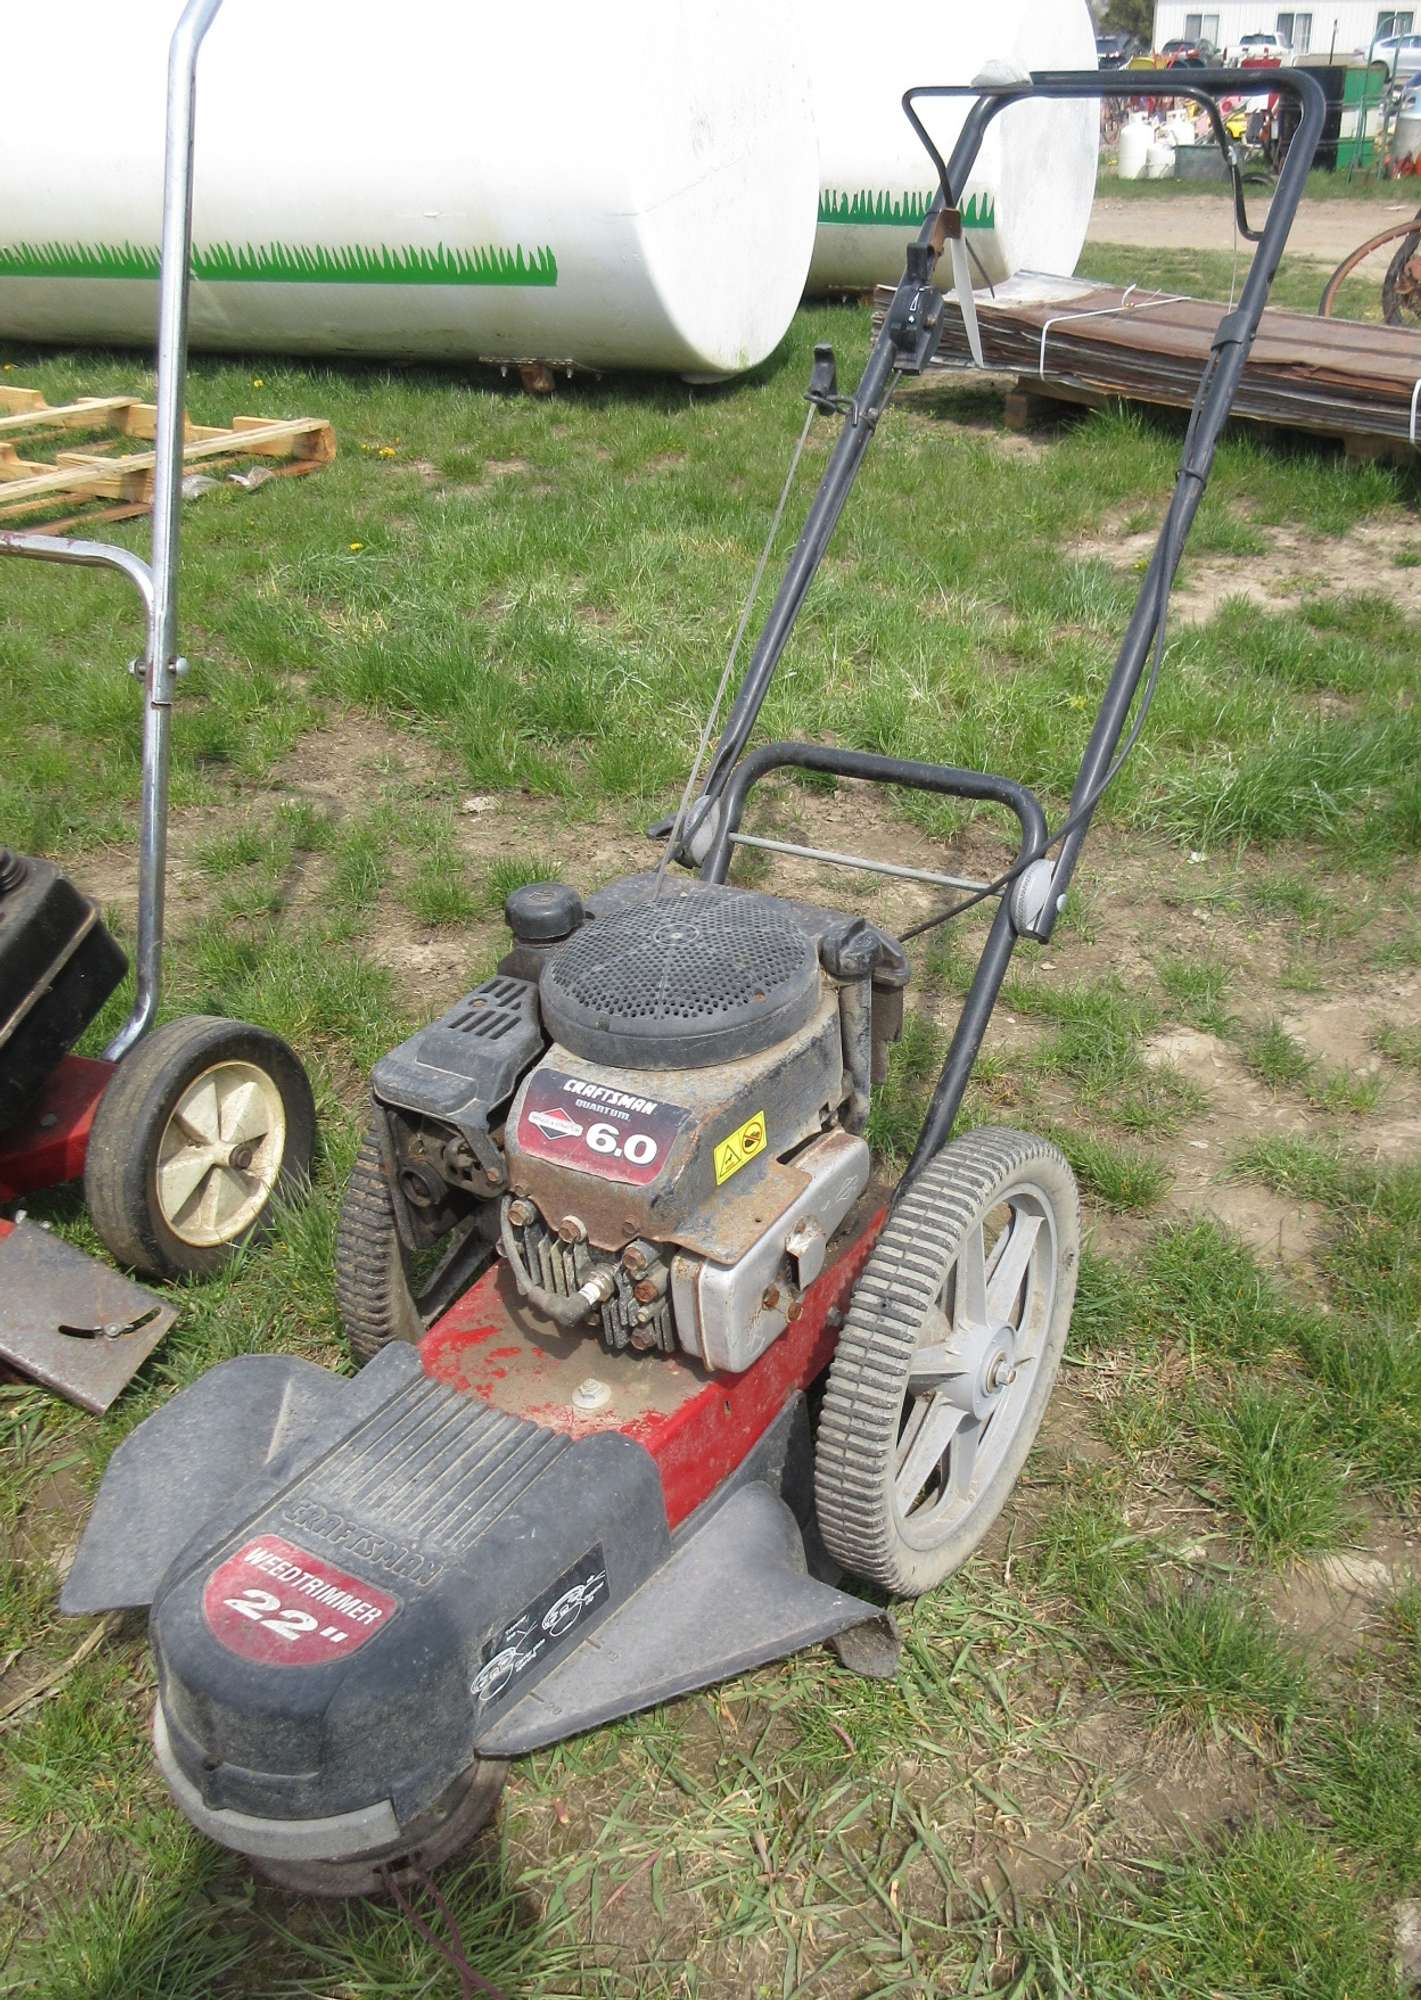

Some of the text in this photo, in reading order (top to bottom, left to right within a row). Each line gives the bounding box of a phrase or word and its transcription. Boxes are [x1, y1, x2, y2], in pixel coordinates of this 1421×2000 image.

[563, 1079, 658, 1115] CRAFTSMAN
[586, 1122, 658, 1165] 6.0
[282, 1501, 444, 1587] CRAFTSMAN
[243, 1547, 383, 1625] WEEDTRIMMER
[223, 1588, 349, 1643] 22"
